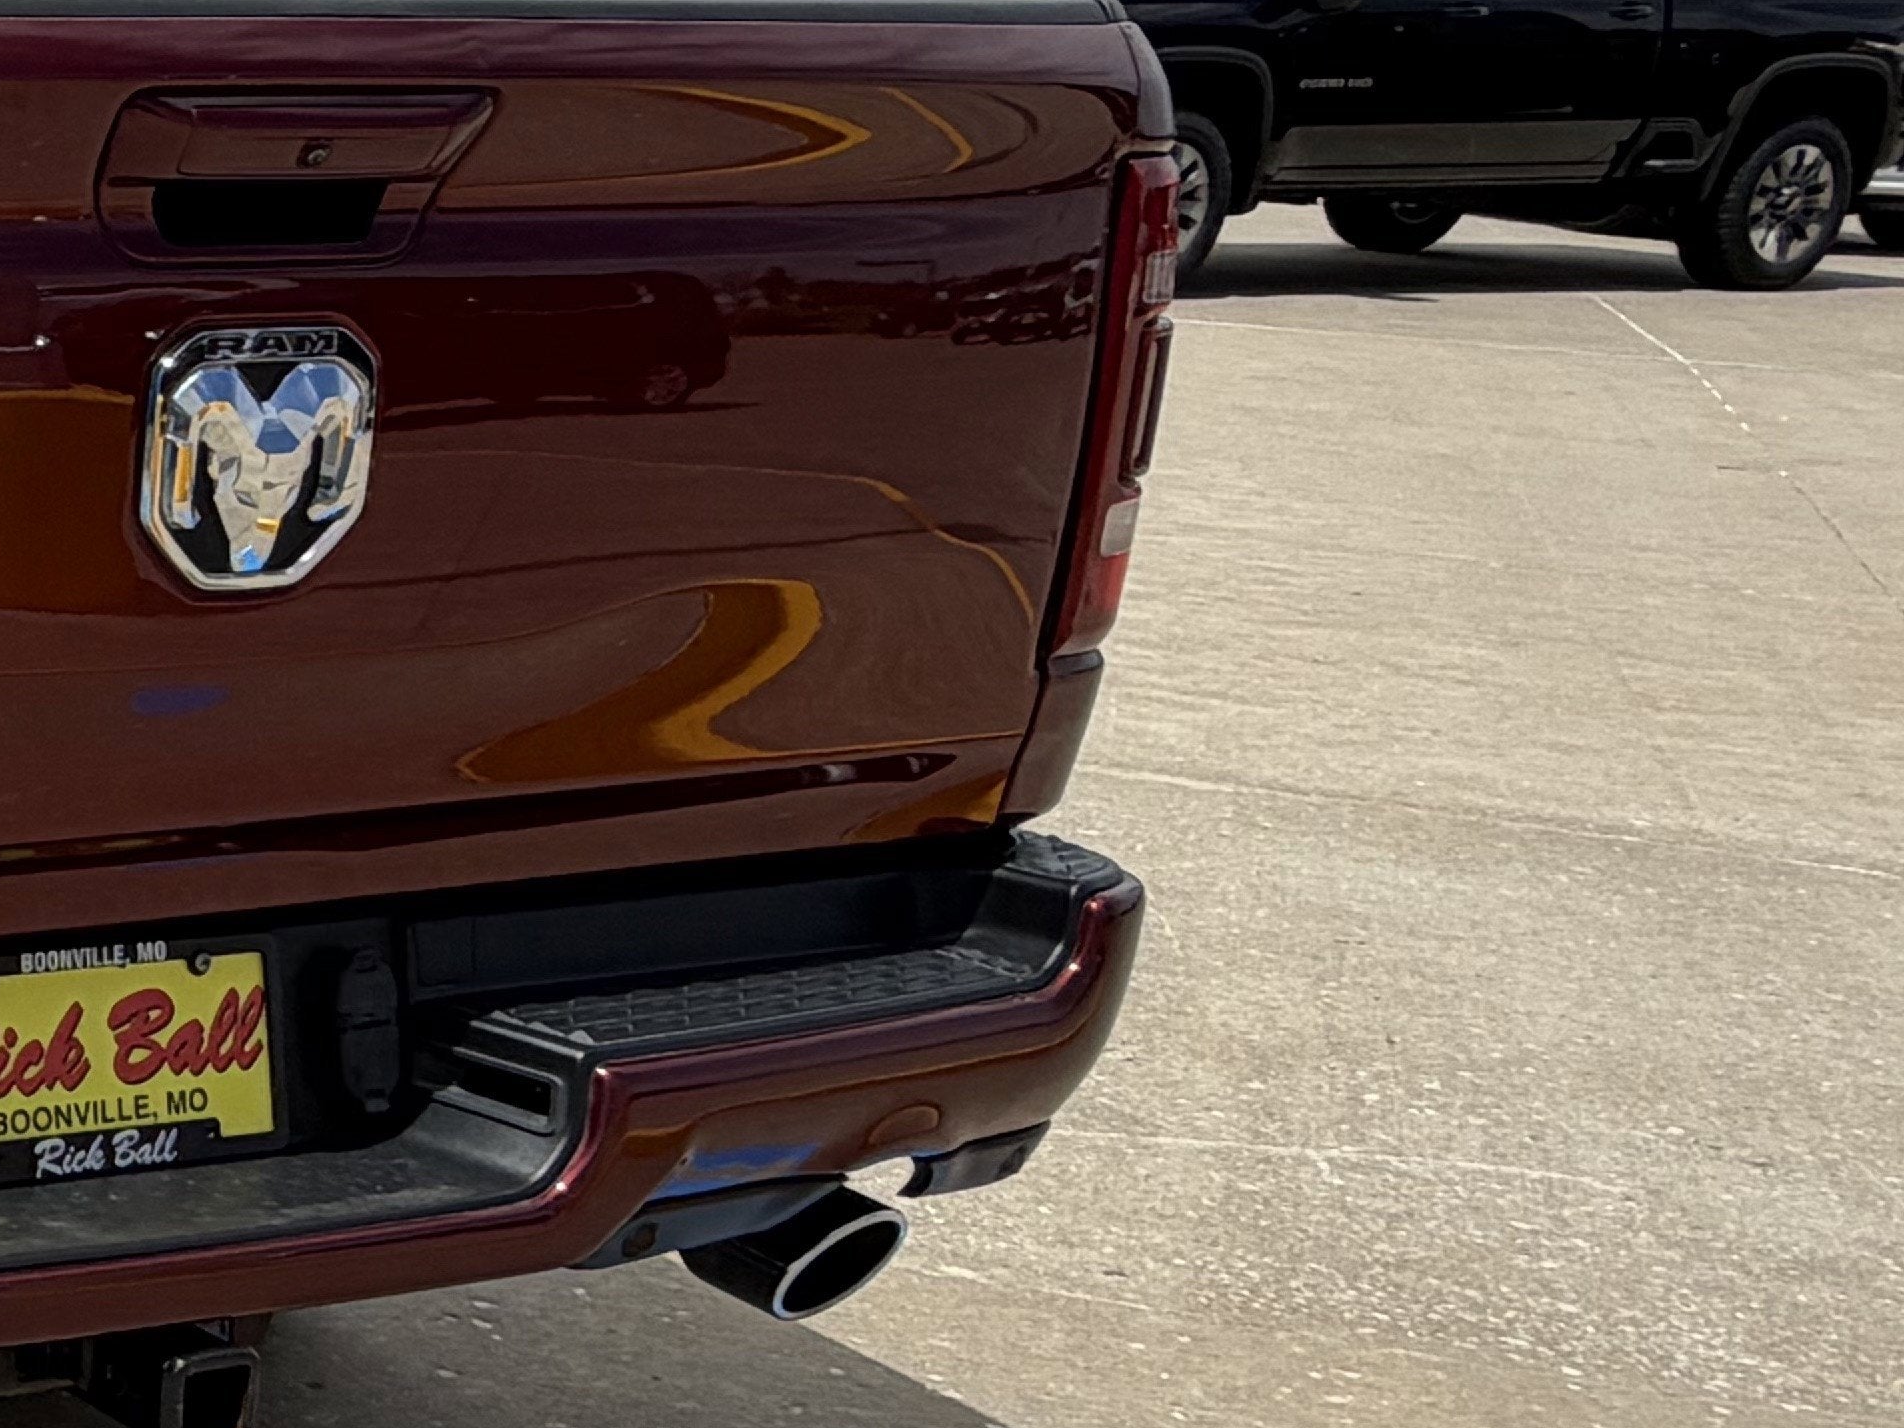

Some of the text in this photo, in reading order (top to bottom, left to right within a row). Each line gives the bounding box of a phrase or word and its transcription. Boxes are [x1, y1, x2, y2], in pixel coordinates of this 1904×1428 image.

[205, 331, 338, 359] RAM
[20, 940, 168, 973] BOONVILLE, MO
[107, 984, 266, 1085] Ball
[166, 1087, 209, 1115] MO
[34, 1127, 179, 1179] Rick Ball
